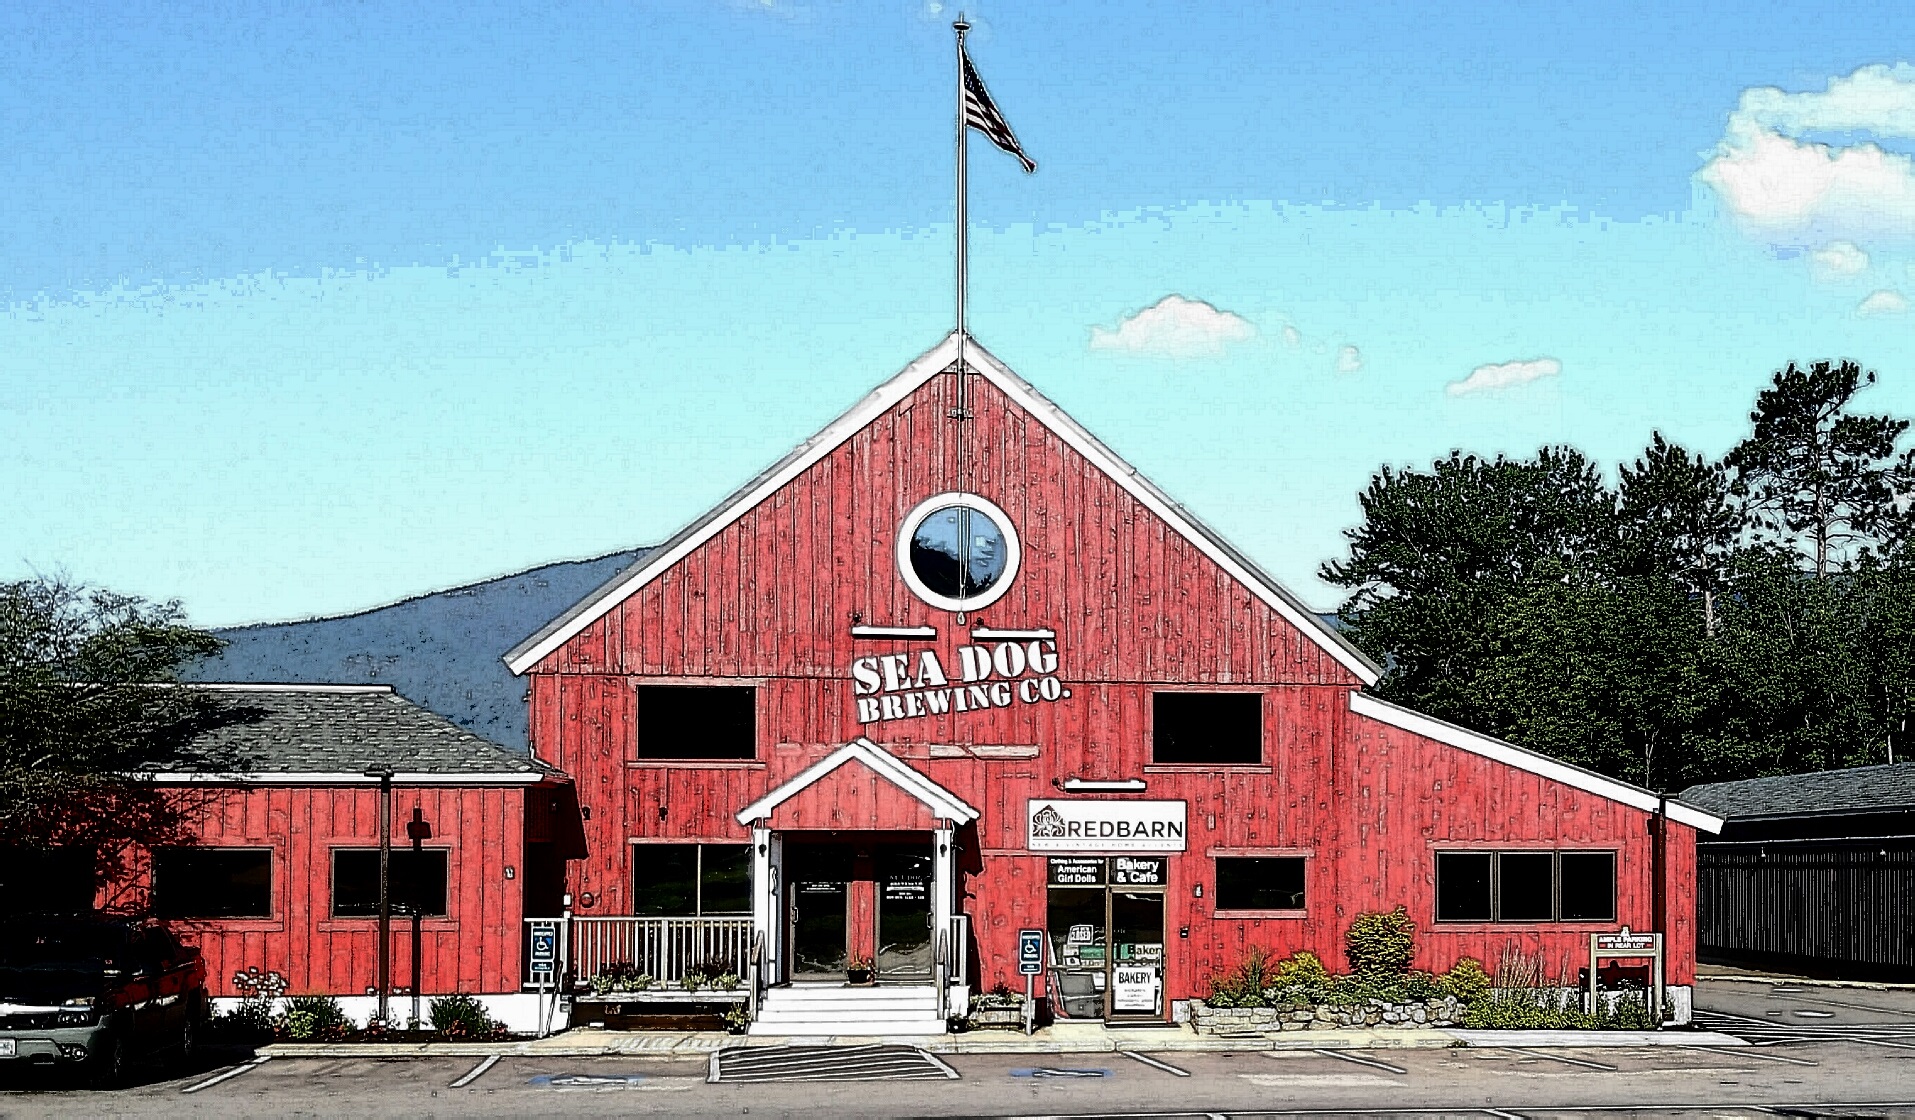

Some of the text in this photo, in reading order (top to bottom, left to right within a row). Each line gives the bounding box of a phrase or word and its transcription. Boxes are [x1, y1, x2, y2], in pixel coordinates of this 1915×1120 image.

[852, 640, 1058, 696] SEA DOG
[857, 676, 1072, 724] BREWING CO.
[1068, 821, 1183, 838] REDBARN
[1057, 865, 1097, 873] American
[1116, 858, 1160, 873] Bakery
[1057, 874, 1097, 883] Girl Dolls
[1116, 871, 1159, 883] & Cafe
[1118, 971, 1152, 984] BAKERY
